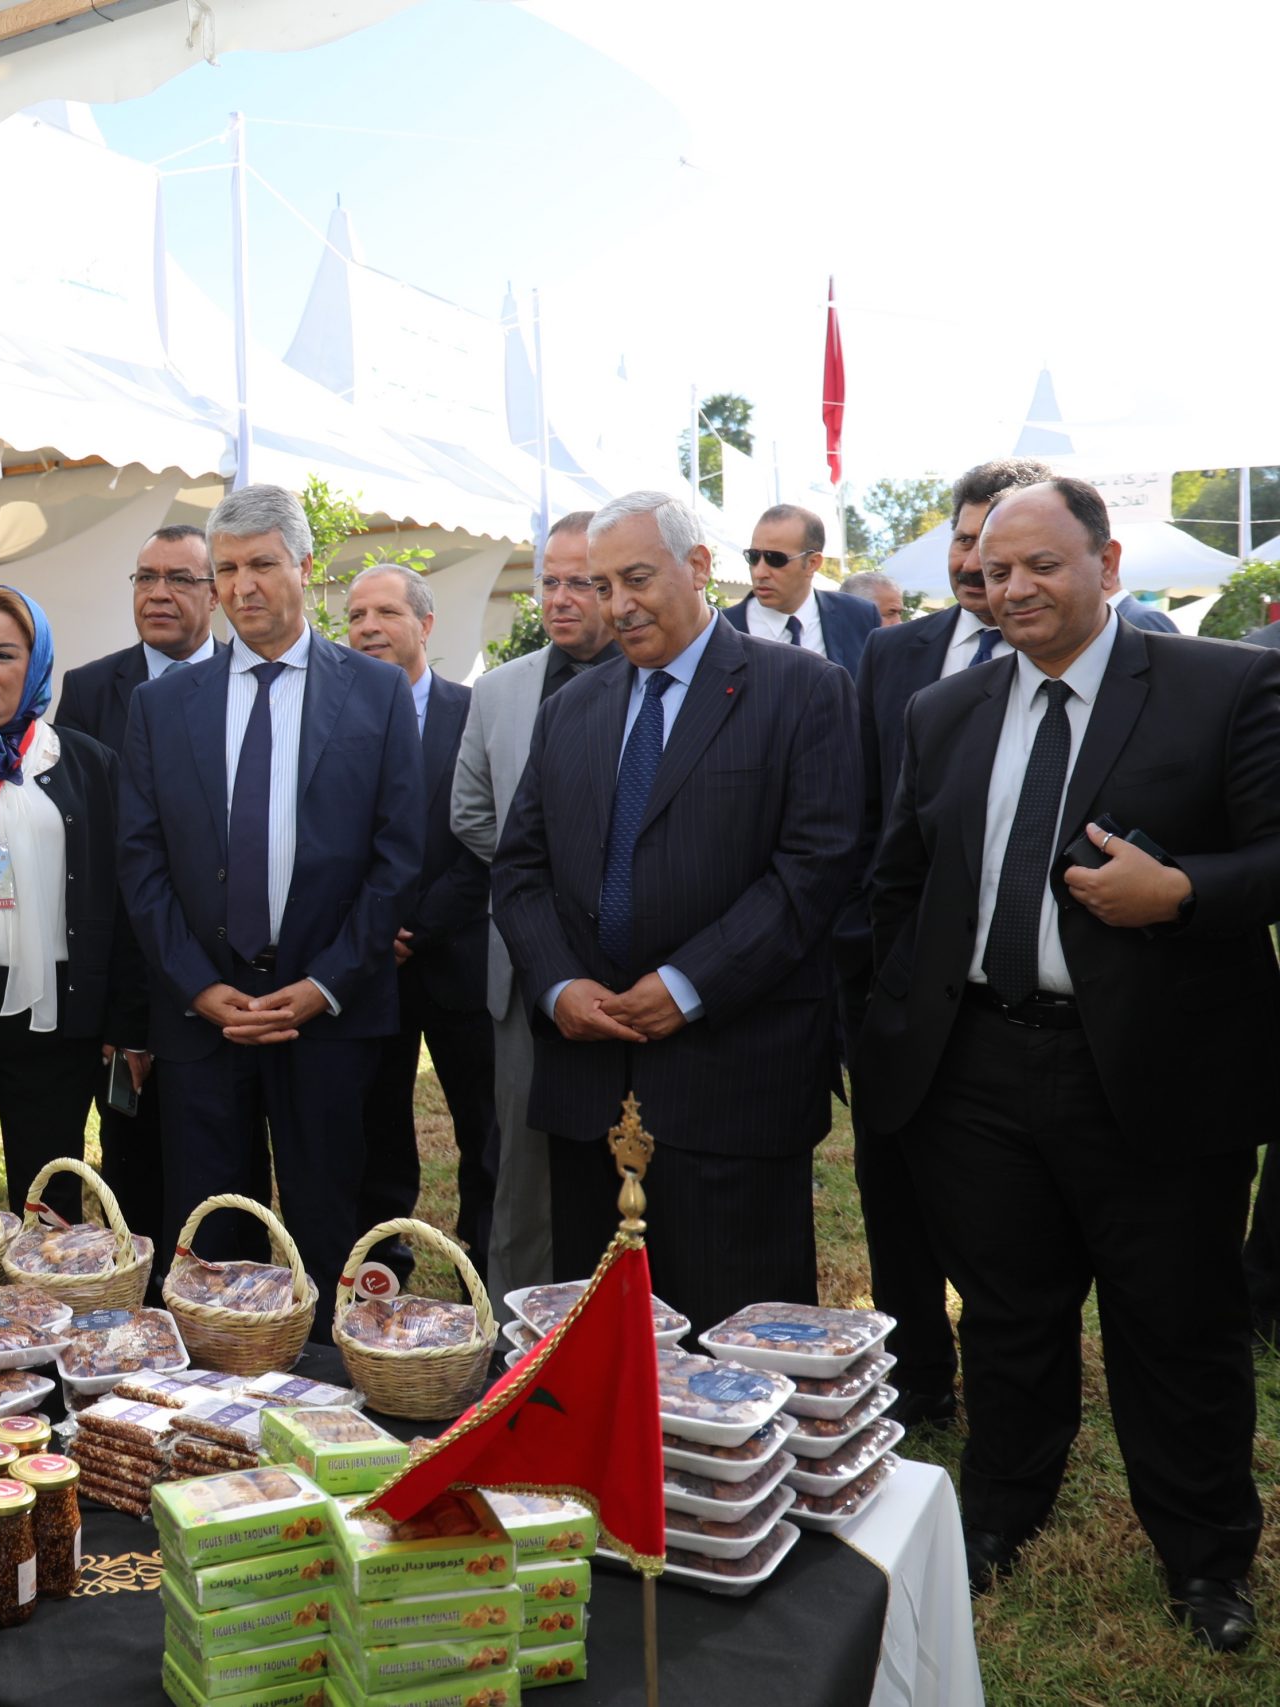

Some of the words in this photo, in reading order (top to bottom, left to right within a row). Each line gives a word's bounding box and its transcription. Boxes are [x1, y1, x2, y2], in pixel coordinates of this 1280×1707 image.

[328, 1459, 350, 1471] FIGUES
[351, 1457, 367, 1470] JIBAL
[369, 1454, 400, 1466] TAOUNATE
[198, 1535, 222, 1550] FIGUES
[224, 1532, 242, 1548] JIBAL
[244, 1524, 280, 1540] TAOUNATE
[213, 1624, 236, 1637] FIGUES
[238, 1619, 256, 1634] JIBAL
[257, 1611, 291, 1626] TAOUNATE
[264, 1657, 296, 1672] TAOUNATE
